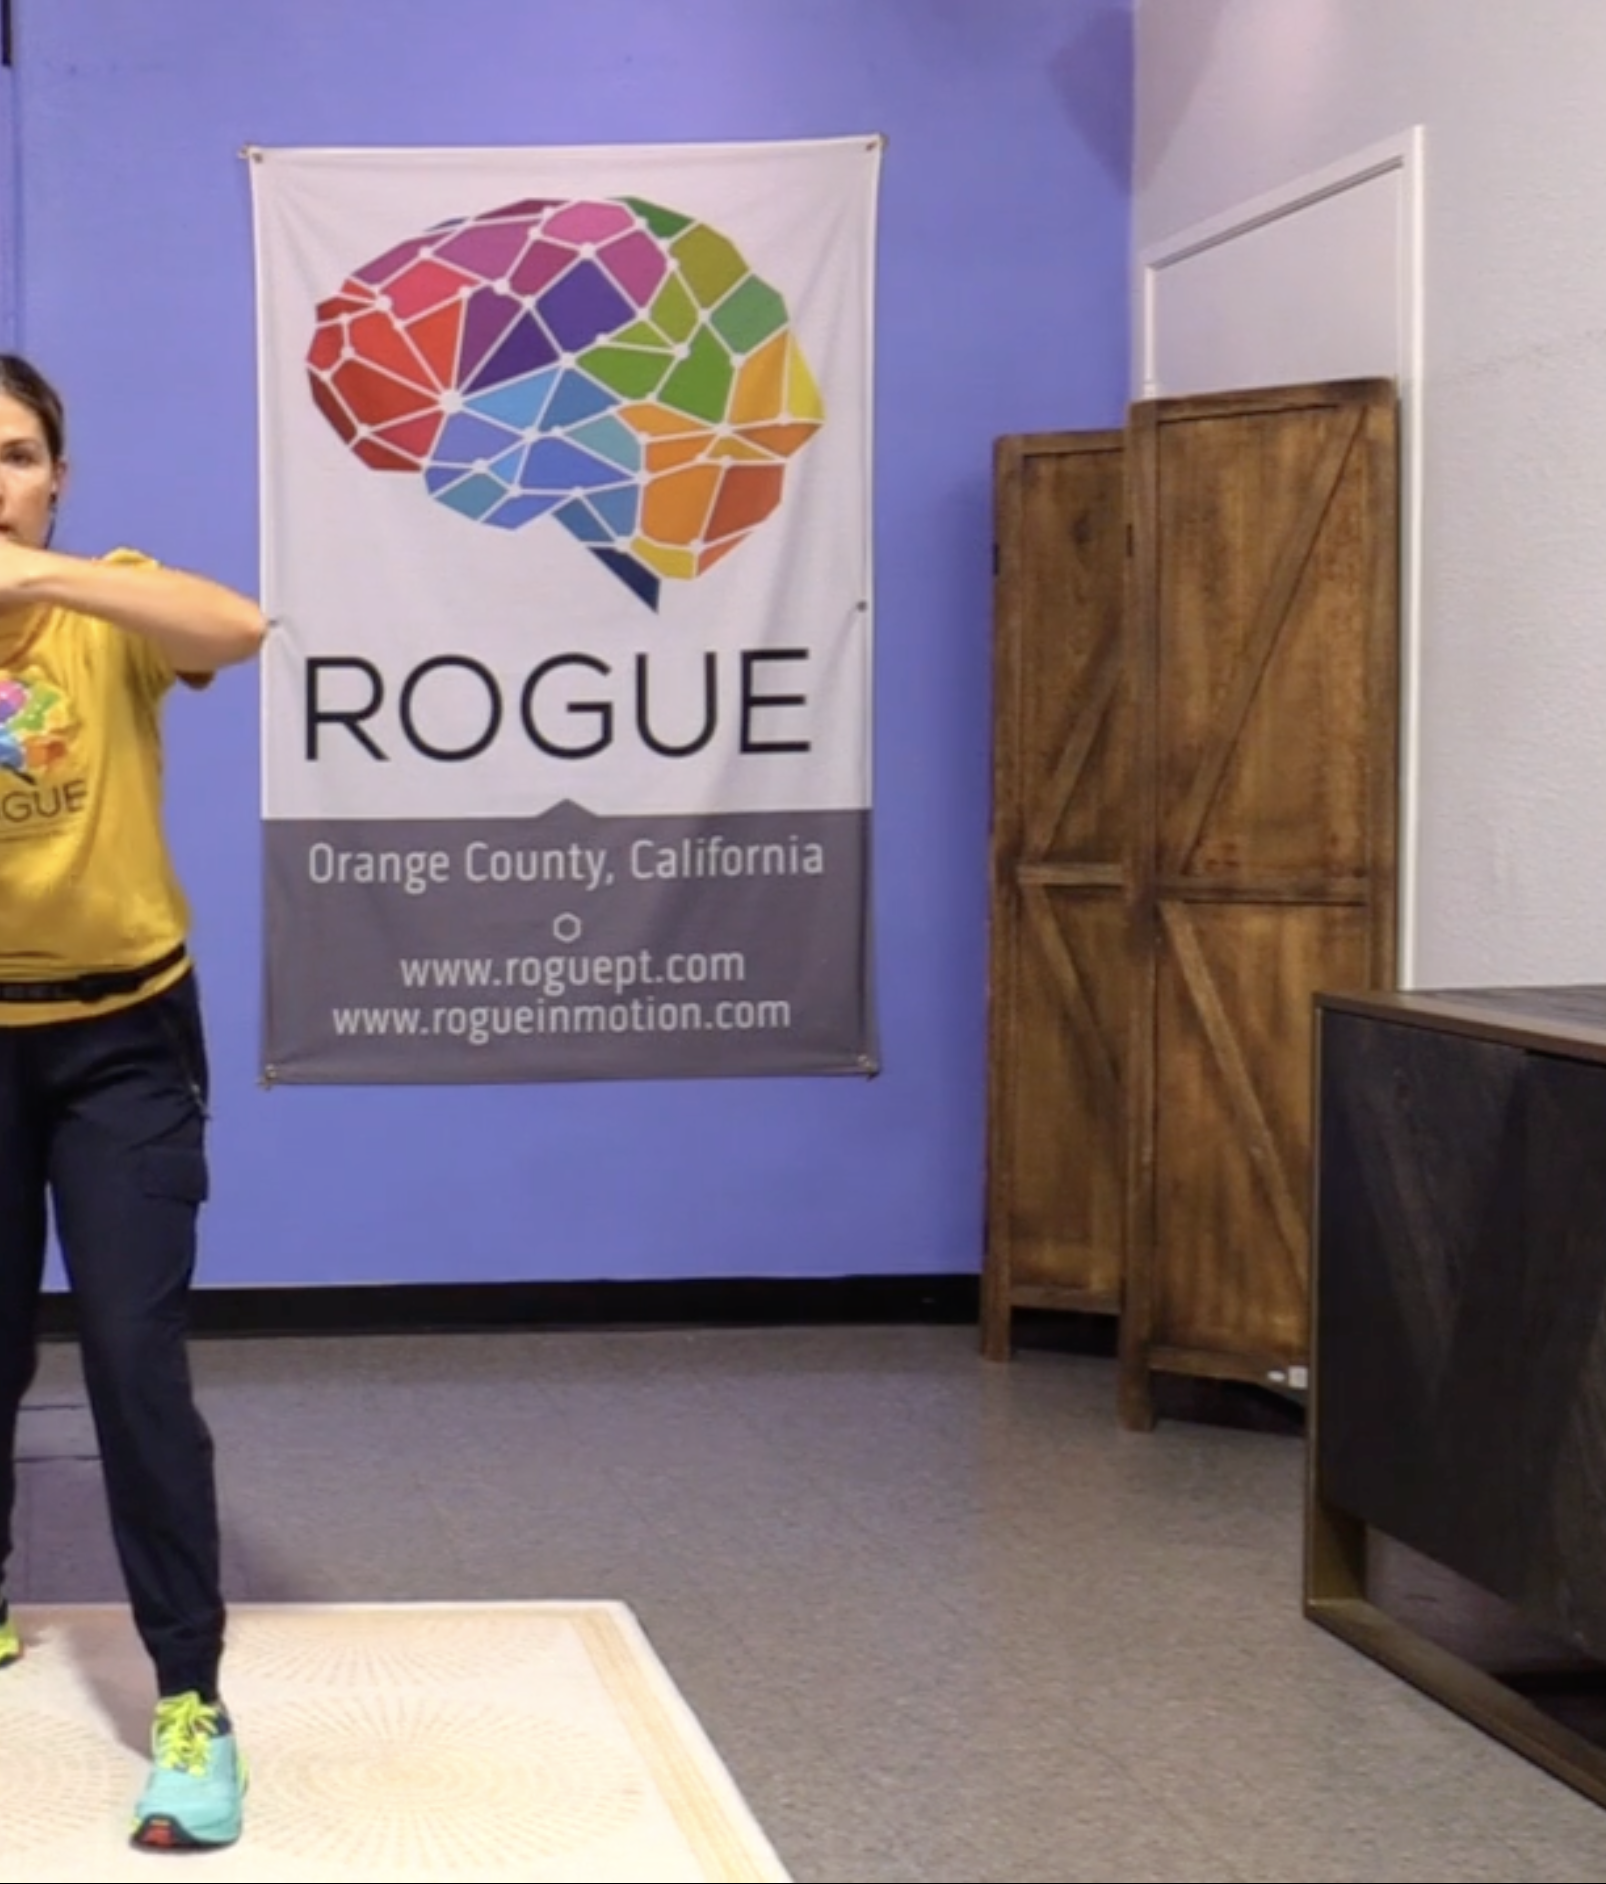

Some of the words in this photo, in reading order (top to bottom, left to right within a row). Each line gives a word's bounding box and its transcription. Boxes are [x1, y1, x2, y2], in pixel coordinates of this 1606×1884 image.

[305, 648, 811, 762] ROGUE
[308, 842, 450, 895] Orange
[464, 840, 615, 888] County,
[630, 836, 824, 880] California
[400, 951, 745, 996] www.roguept.com
[332, 997, 791, 1045] www.rogueinmotion.com
